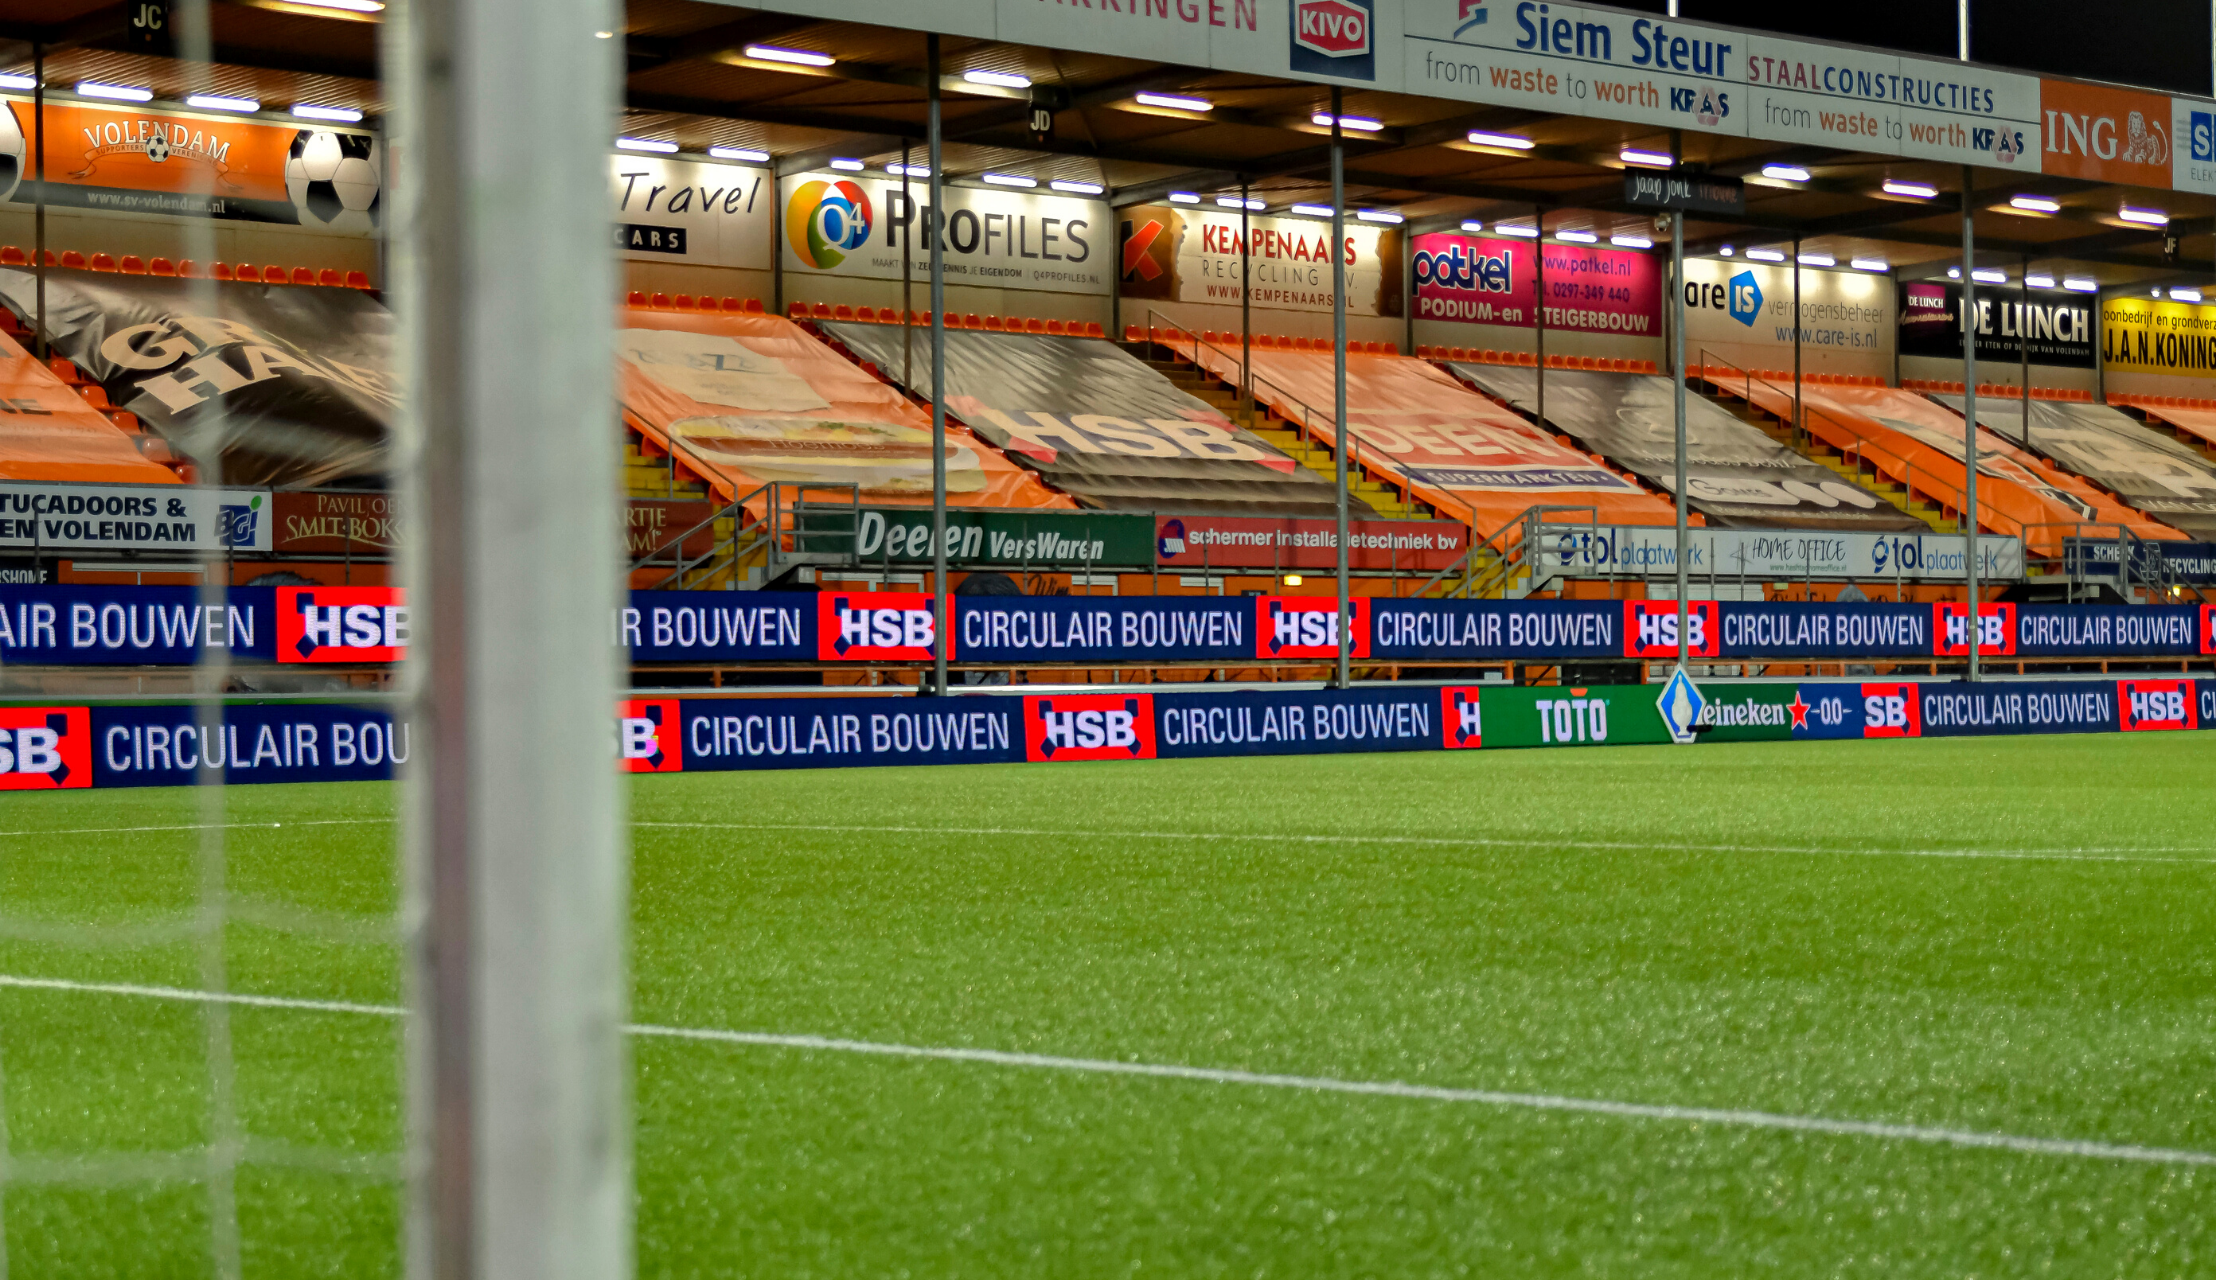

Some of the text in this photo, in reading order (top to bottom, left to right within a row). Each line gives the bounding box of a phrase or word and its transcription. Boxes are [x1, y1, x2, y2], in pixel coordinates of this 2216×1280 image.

[133, 4, 163, 30] JC
[1302, 9, 1363, 43] KIVO
[1516, 1, 1732, 77] Siem Steur
[1426, 51, 1481, 85] from
[1489, 66, 1558, 95] waste
[1567, 73, 1587, 99] to
[1595, 80, 1660, 108] worth
[1748, 55, 1995, 114] STAALCONSTRUCTIES
[1030, 109, 1052, 131] JD
[1765, 98, 1811, 130] from
[1819, 111, 1878, 138] waste
[1886, 116, 1904, 140] to
[1909, 124, 1967, 149] worth
[2046, 110, 2119, 162] ING
[84, 120, 231, 164] VOLENDAM
[87, 191, 226, 214] www.sv-volendam.nl
[620, 171, 763, 216] Travel
[612, 231, 681, 250] CARS
[816, 202, 866, 252] Q4
[2164, 236, 2177, 254] JF
[980, 267, 1023, 278] EIGENDOM
[1412, 244, 1512, 297] patkel
[1533, 280, 1631, 302] Tl. 0297-349 440
[1671, 281, 1726, 310] are
[1908, 295, 1944, 309] DE LUNCH
[1421, 297, 1523, 322] PODIUM-en
[2001, 301, 2090, 343] LUNCH
[2104, 309, 2153, 328] oonbedrijf
[2157, 316, 2168, 327] en
[1775, 325, 1878, 348] www.care-is.nl
[1424, 469, 1599, 488] SUPERMARKTEN
[166, 495, 188, 517] &
[45, 520, 196, 542] VOLENDAM
[990, 532, 1105, 560] VersWaren
[1189, 529, 1458, 551] schermer installaietechniek bv
[1621, 542, 1704, 570] plaatwrk
[1752, 537, 1846, 562] HOME OFFICE
[1892, 535, 1923, 571] tol
[2093, 545, 2135, 561] SCHEK
[73, 603, 255, 648] BOUWEN
[653, 606, 801, 647] BOUWEN
[841, 608, 936, 648] HSB
[964, 610, 1242, 648] CIRCULAIR BOUWEN
[1377, 611, 1611, 647] CIRCULAIR BOUWEN
[1639, 613, 1705, 646] HSB
[1724, 613, 1923, 647] CIRCULAIR BOUWEN
[2021, 615, 2192, 646] CIRCULAIR BOUWEN
[1536, 698, 1608, 743] TOTO
[1697, 698, 1786, 728] eineken
[1925, 693, 2110, 727] CIRCULAIR BOUWEN
[2130, 691, 2187, 722] HSB
[691, 711, 1010, 757] CIRCULAIR BOUWEN
[1045, 709, 1136, 748] HSB
[1164, 702, 1430, 746] CIRCULAIR BOUWEN
[105, 723, 320, 772] CIRCULAIR
